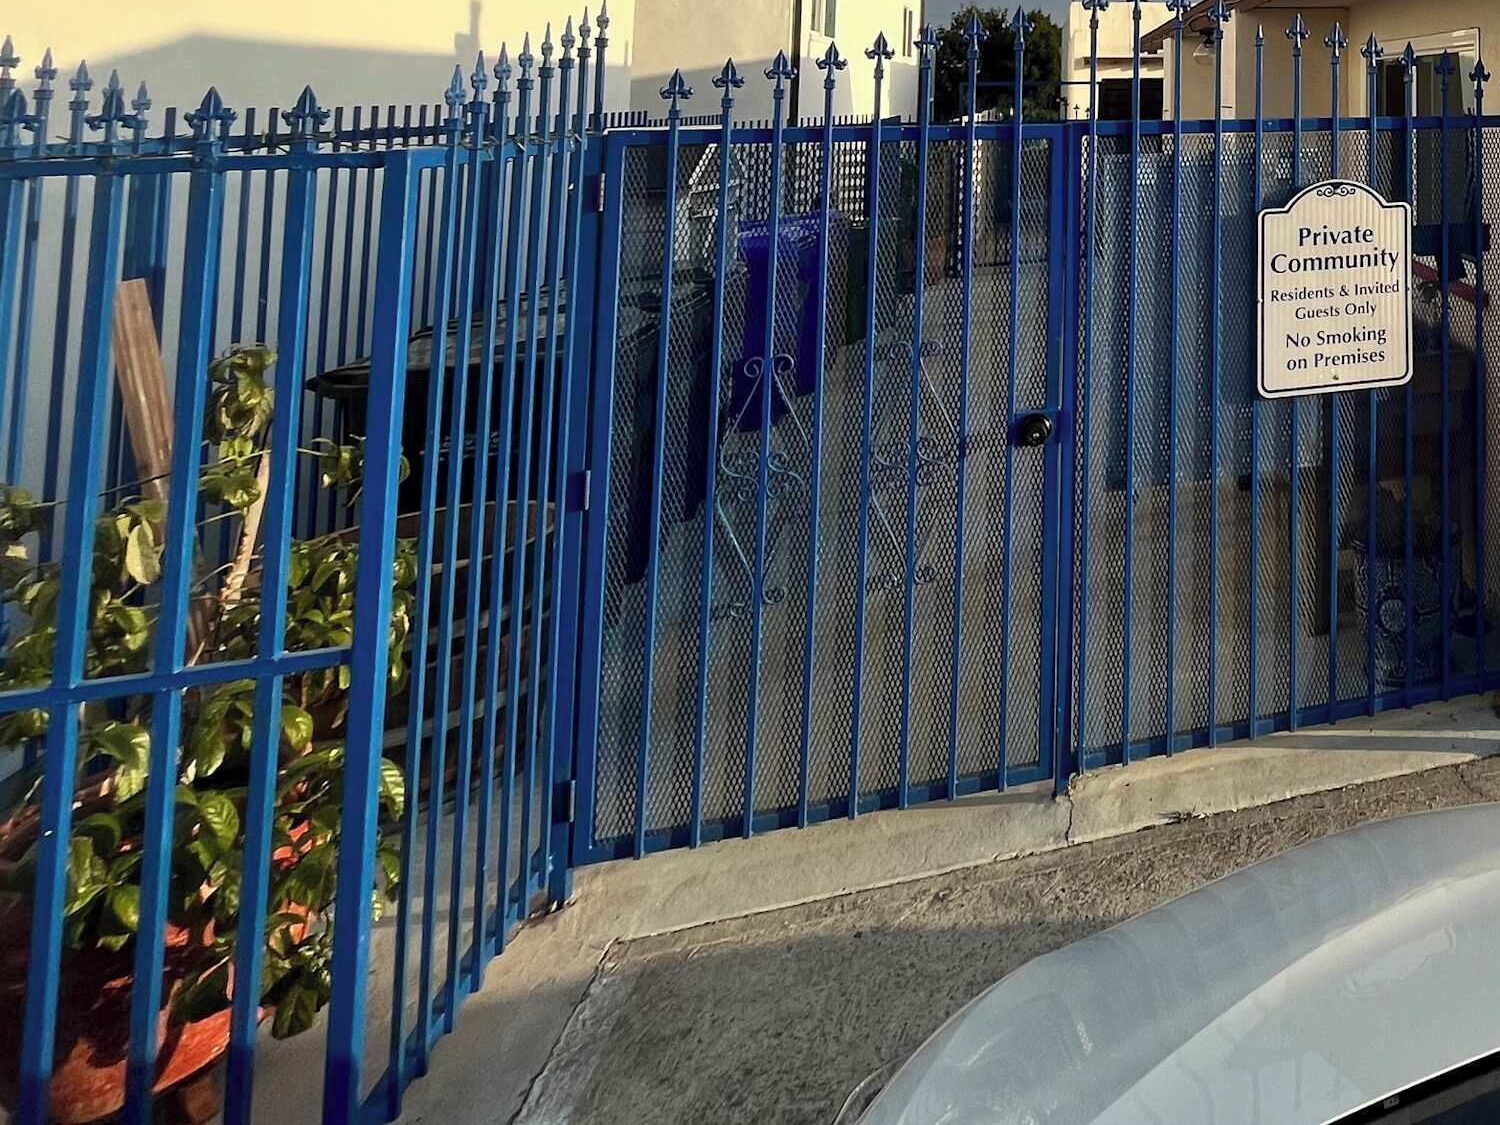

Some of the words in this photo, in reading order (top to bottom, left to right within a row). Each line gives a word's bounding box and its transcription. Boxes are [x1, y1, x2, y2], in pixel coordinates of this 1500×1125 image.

[1298, 224, 1374, 247] Private
[1270, 247, 1400, 274] Community
[1270, 286, 1335, 302] Residents
[1339, 284, 1350, 297] &
[1354, 279, 1400, 296] Invited
[1295, 304, 1340, 320] Guests
[1344, 301, 1377, 318] Only
[1285, 332, 1311, 349] No
[1316, 325, 1387, 346] Smoking
[1286, 357, 1307, 371] on
[1314, 347, 1386, 369] Premises
